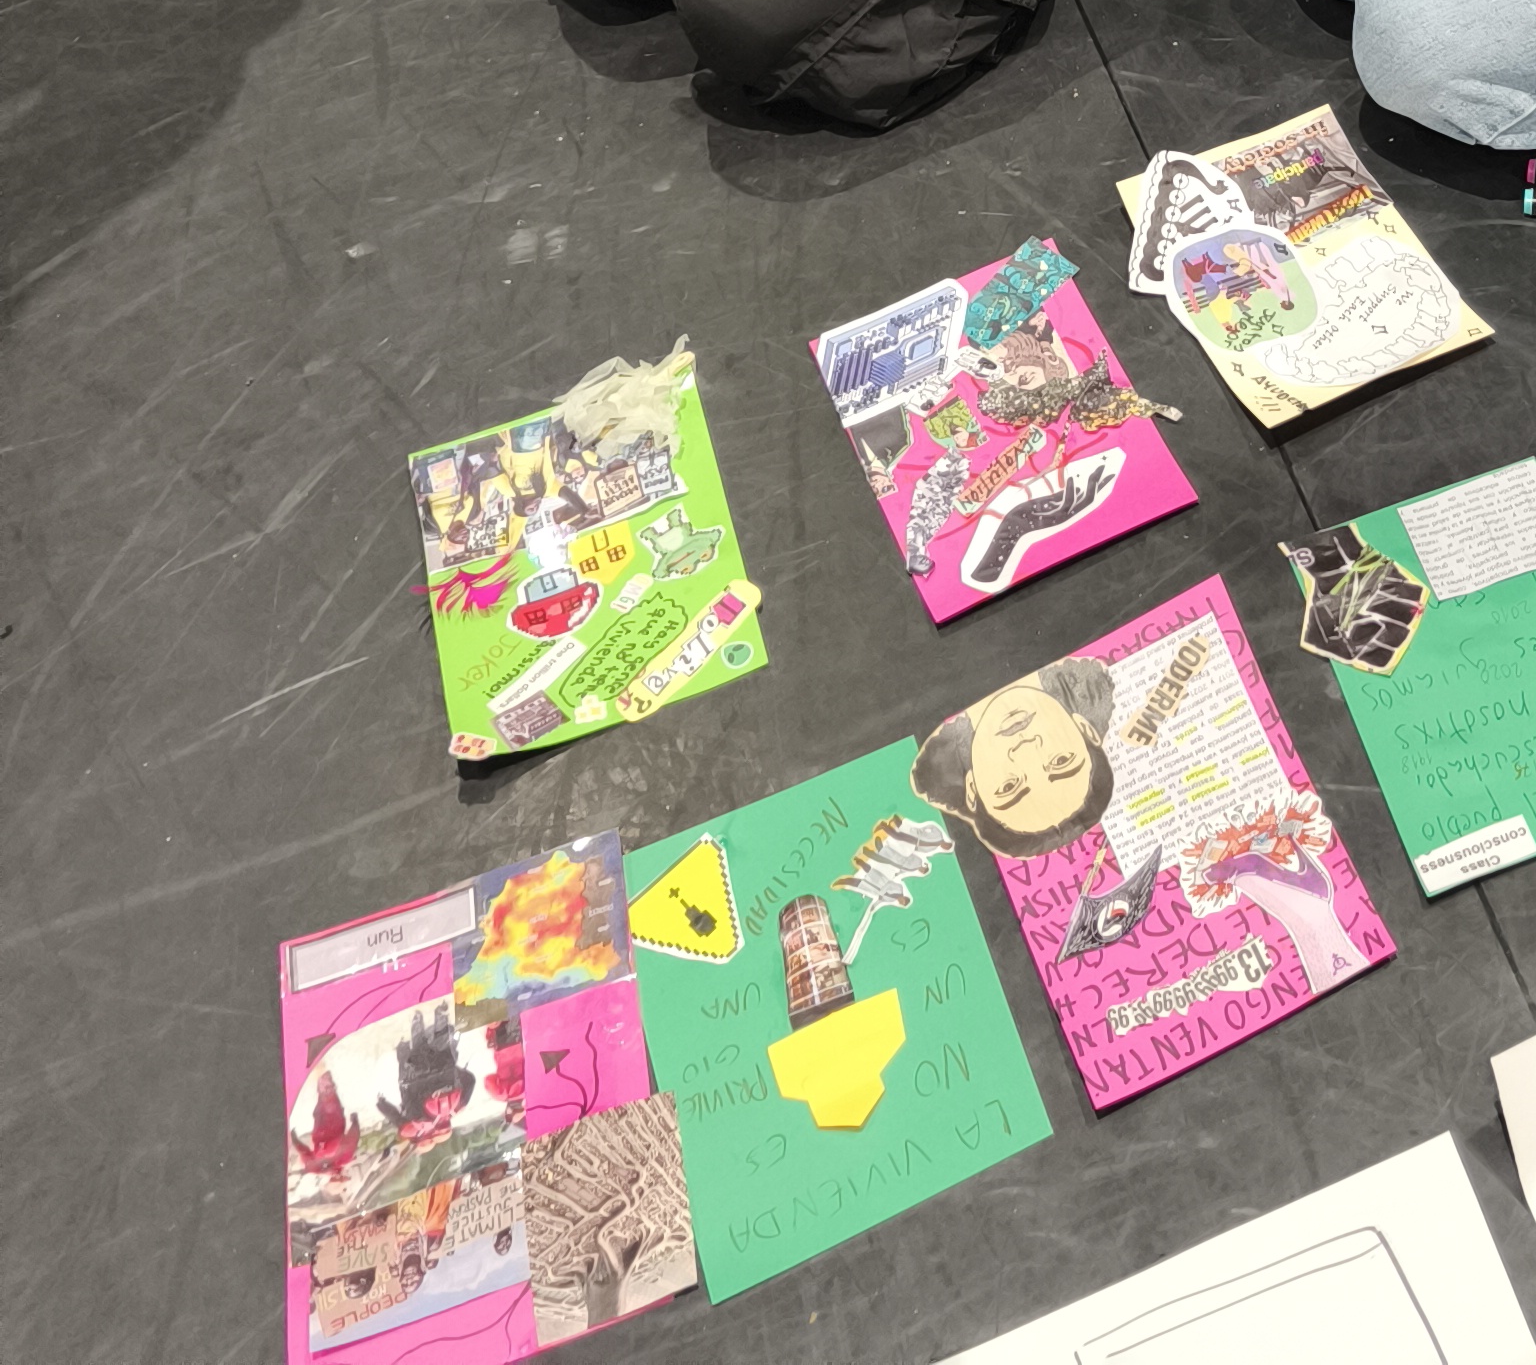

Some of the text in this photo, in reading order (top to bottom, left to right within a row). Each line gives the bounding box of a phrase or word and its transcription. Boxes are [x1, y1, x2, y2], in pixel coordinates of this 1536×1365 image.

[1220, 134, 1297, 172] society
[1250, 148, 1324, 191] participate
[1338, 296, 1366, 322] Each
[1357, 283, 1397, 323] Support
[1394, 290, 1414, 307] We
[636, 605, 665, 638] que
[554, 640, 574, 659] One
[604, 618, 679, 693] Hay gente
[645, 632, 712, 692] Live
[527, 657, 558, 684] trillion
[745, 796, 848, 936] NECESIDAD
[1418, 826, 1526, 875] consciousness
[1458, 854, 1501, 874] Class
[366, 924, 404, 947] Run
[699, 917, 930, 1021] ES UNA
[924, 963, 965, 1012] UN
[680, 1044, 739, 1083] GIO
[745, 1041, 969, 1174] NO ES
[726, 1099, 1011, 1253] LA VIVIENDA
[450, 1196, 510, 1231] JUSTICE
[337, 1241, 388, 1273] SAVE
[329, 1291, 407, 1330] PEOPLE
